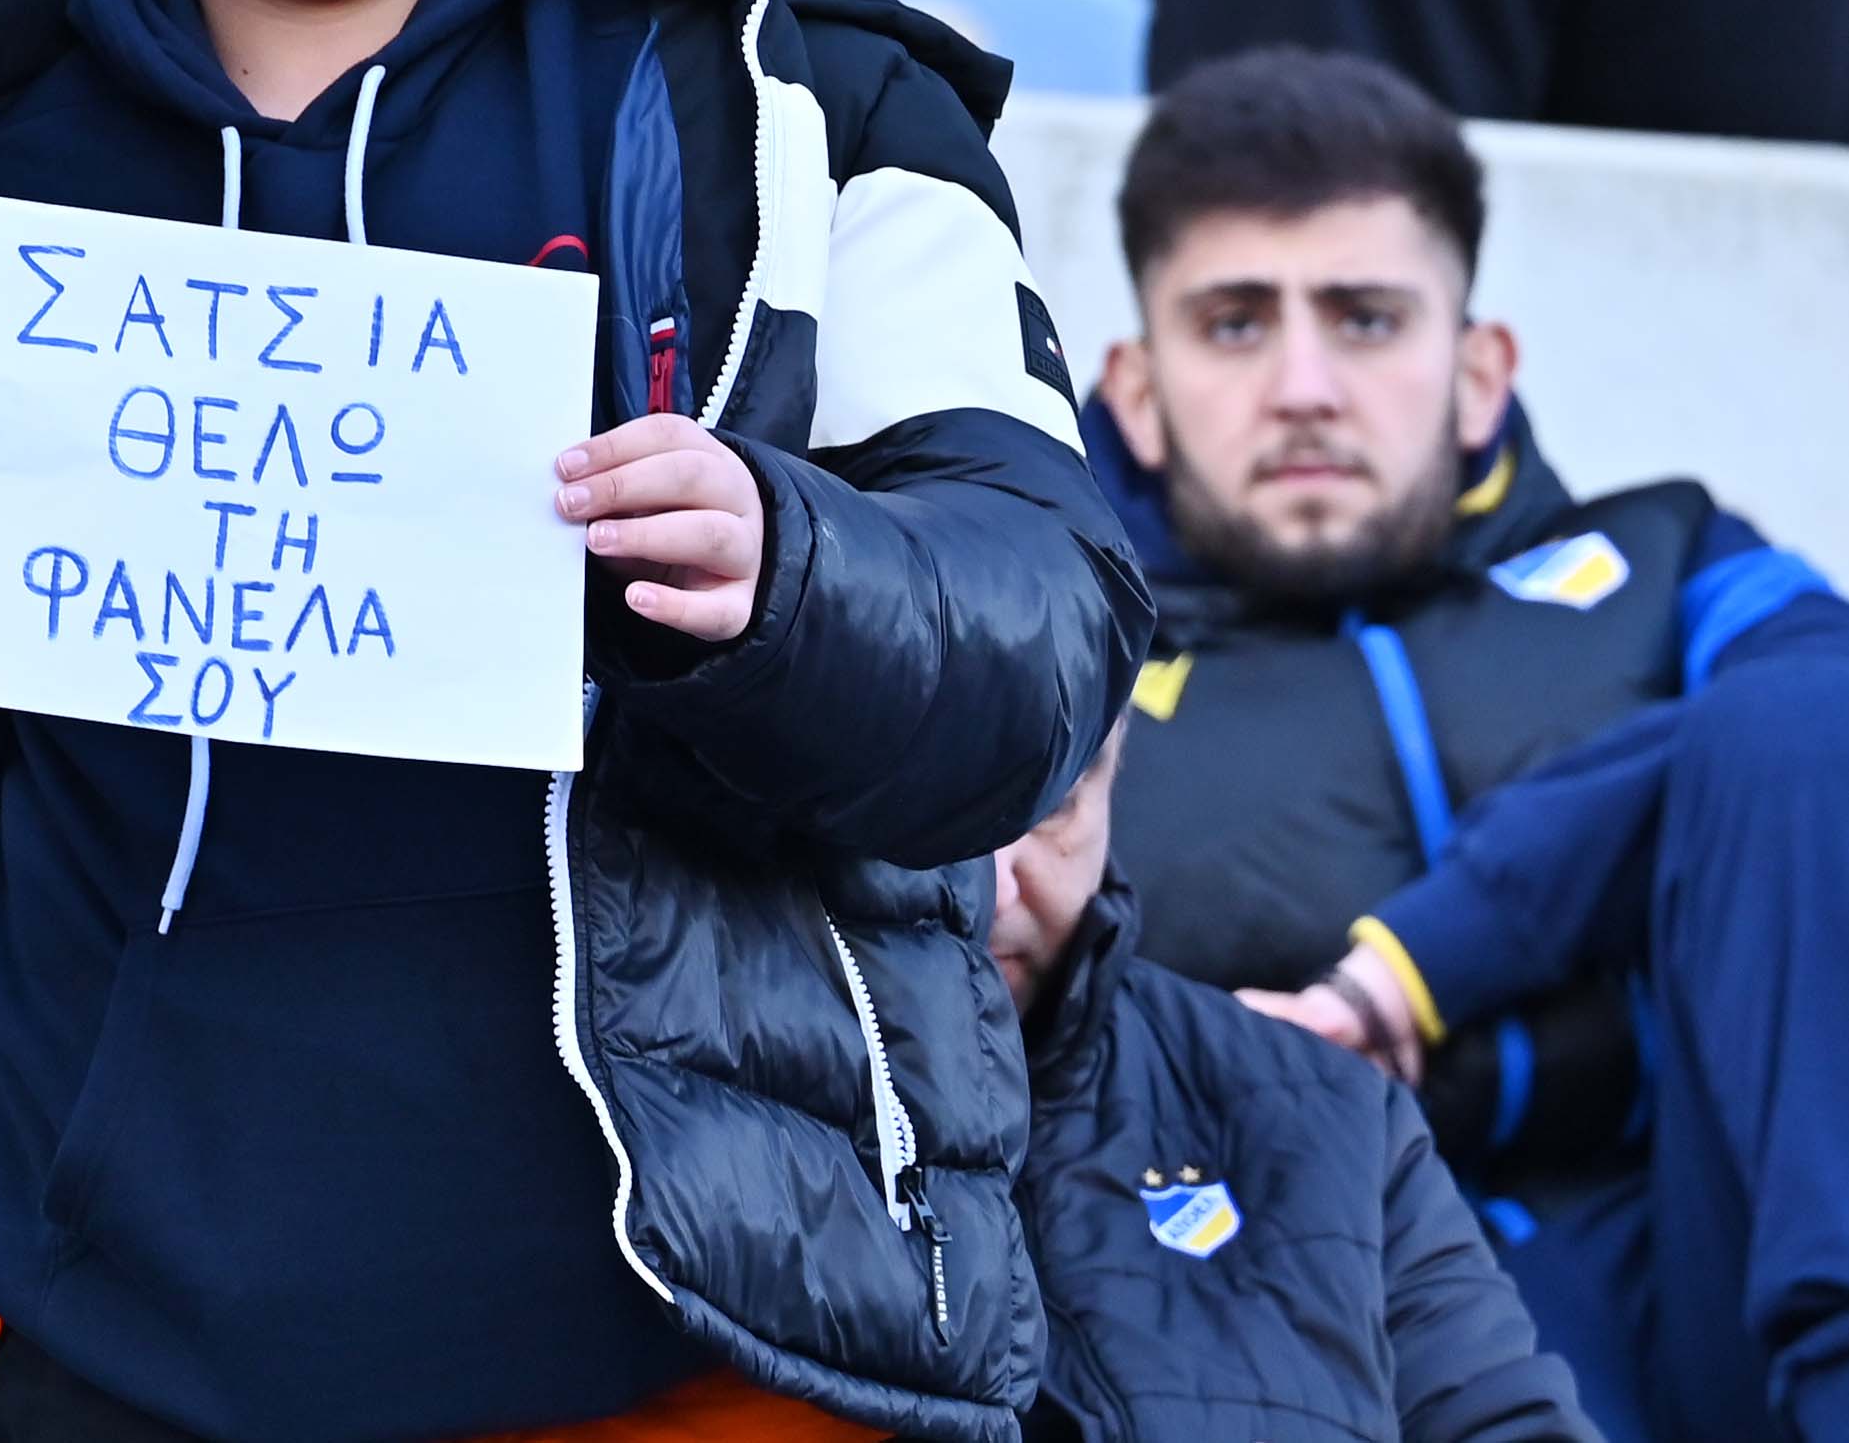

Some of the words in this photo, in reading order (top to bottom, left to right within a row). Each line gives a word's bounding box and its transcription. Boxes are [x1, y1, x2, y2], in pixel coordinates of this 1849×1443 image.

[15, 244, 469, 376] ΣΑΤΣΙΑ
[107, 384, 386, 488] ΘΕΛΩ
[202, 499, 320, 575] ΤΗ
[22, 545, 397, 659] ΦΑΝΕΛΑ
[126, 650, 297, 740] ΣΟΥ
